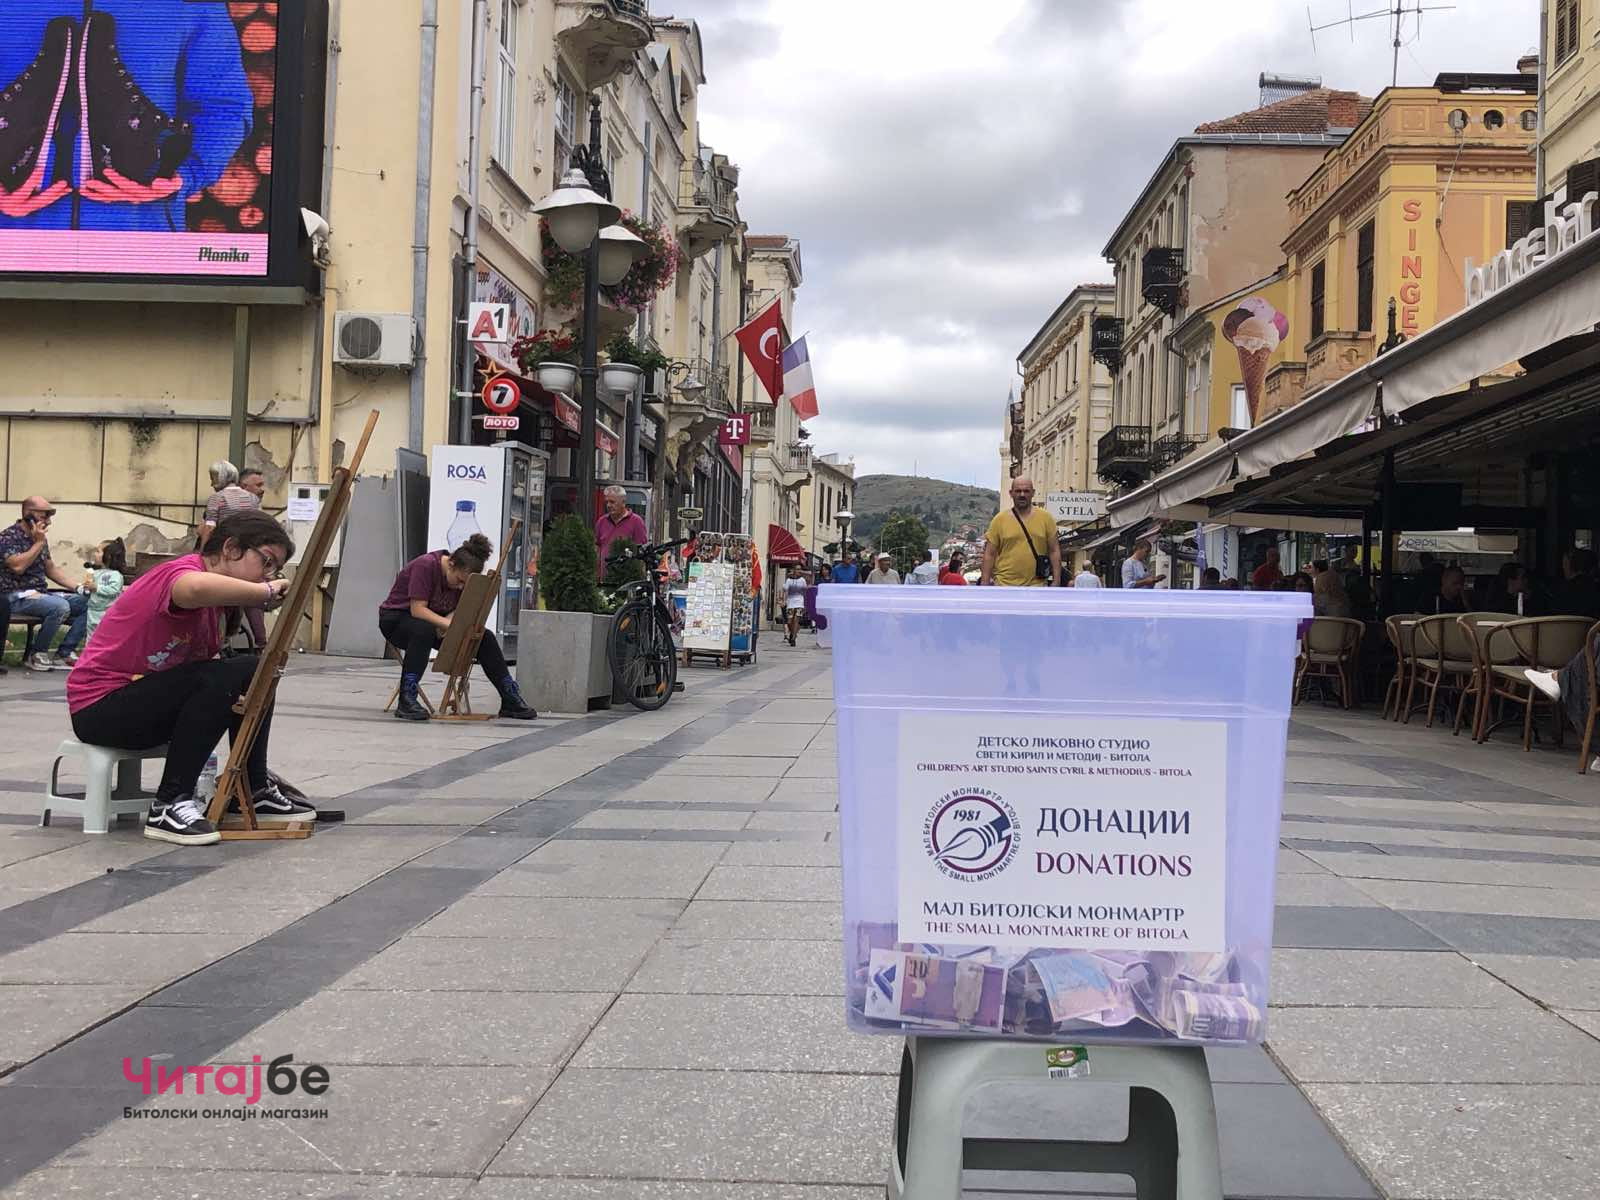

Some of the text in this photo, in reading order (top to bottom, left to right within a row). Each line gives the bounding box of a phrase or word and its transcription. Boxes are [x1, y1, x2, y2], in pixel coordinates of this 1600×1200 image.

[198, 246, 249, 263] Planika
[472, 307, 505, 338] A1
[492, 386, 509, 404] 7
[726, 418, 744, 440] T
[447, 464, 487, 480] ROSA
[1059, 506, 1095, 516] STELA
[977, 736, 1151, 752] ДЕТСКО ЛИКОВНО СТУДИО
[975, 750, 1008, 759] СВЕТИ
[1010, 751, 1044, 760] КИРИЛ
[1047, 752, 1054, 760] И
[1110, 754, 1151, 762] БИТОЛА
[971, 764, 988, 773] ART
[990, 765, 1024, 773] STUDIO
[1026, 766, 1058, 774] SAINTS
[1060, 767, 1087, 775] CYRIL
[1096, 767, 1151, 776] METHODIUS
[1159, 768, 1192, 777] BITOLA
[923, 794, 952, 835] БИТОЛСКИ
[952, 787, 1002, 802] МОНМАРТР
[953, 809, 981, 821] 1981
[1036, 807, 1190, 840] ДОНАЦИИ
[935, 802, 1022, 882] THE SMALL MONTMARTRE OF BITOLA
[1035, 851, 1192, 877] DONATIONS
[923, 901, 1185, 922] МАЛ БИТОЛСКИ МОНМАРТР
[925, 921, 1189, 940] THE SMALL MONTMARTRE OF BITOLA
